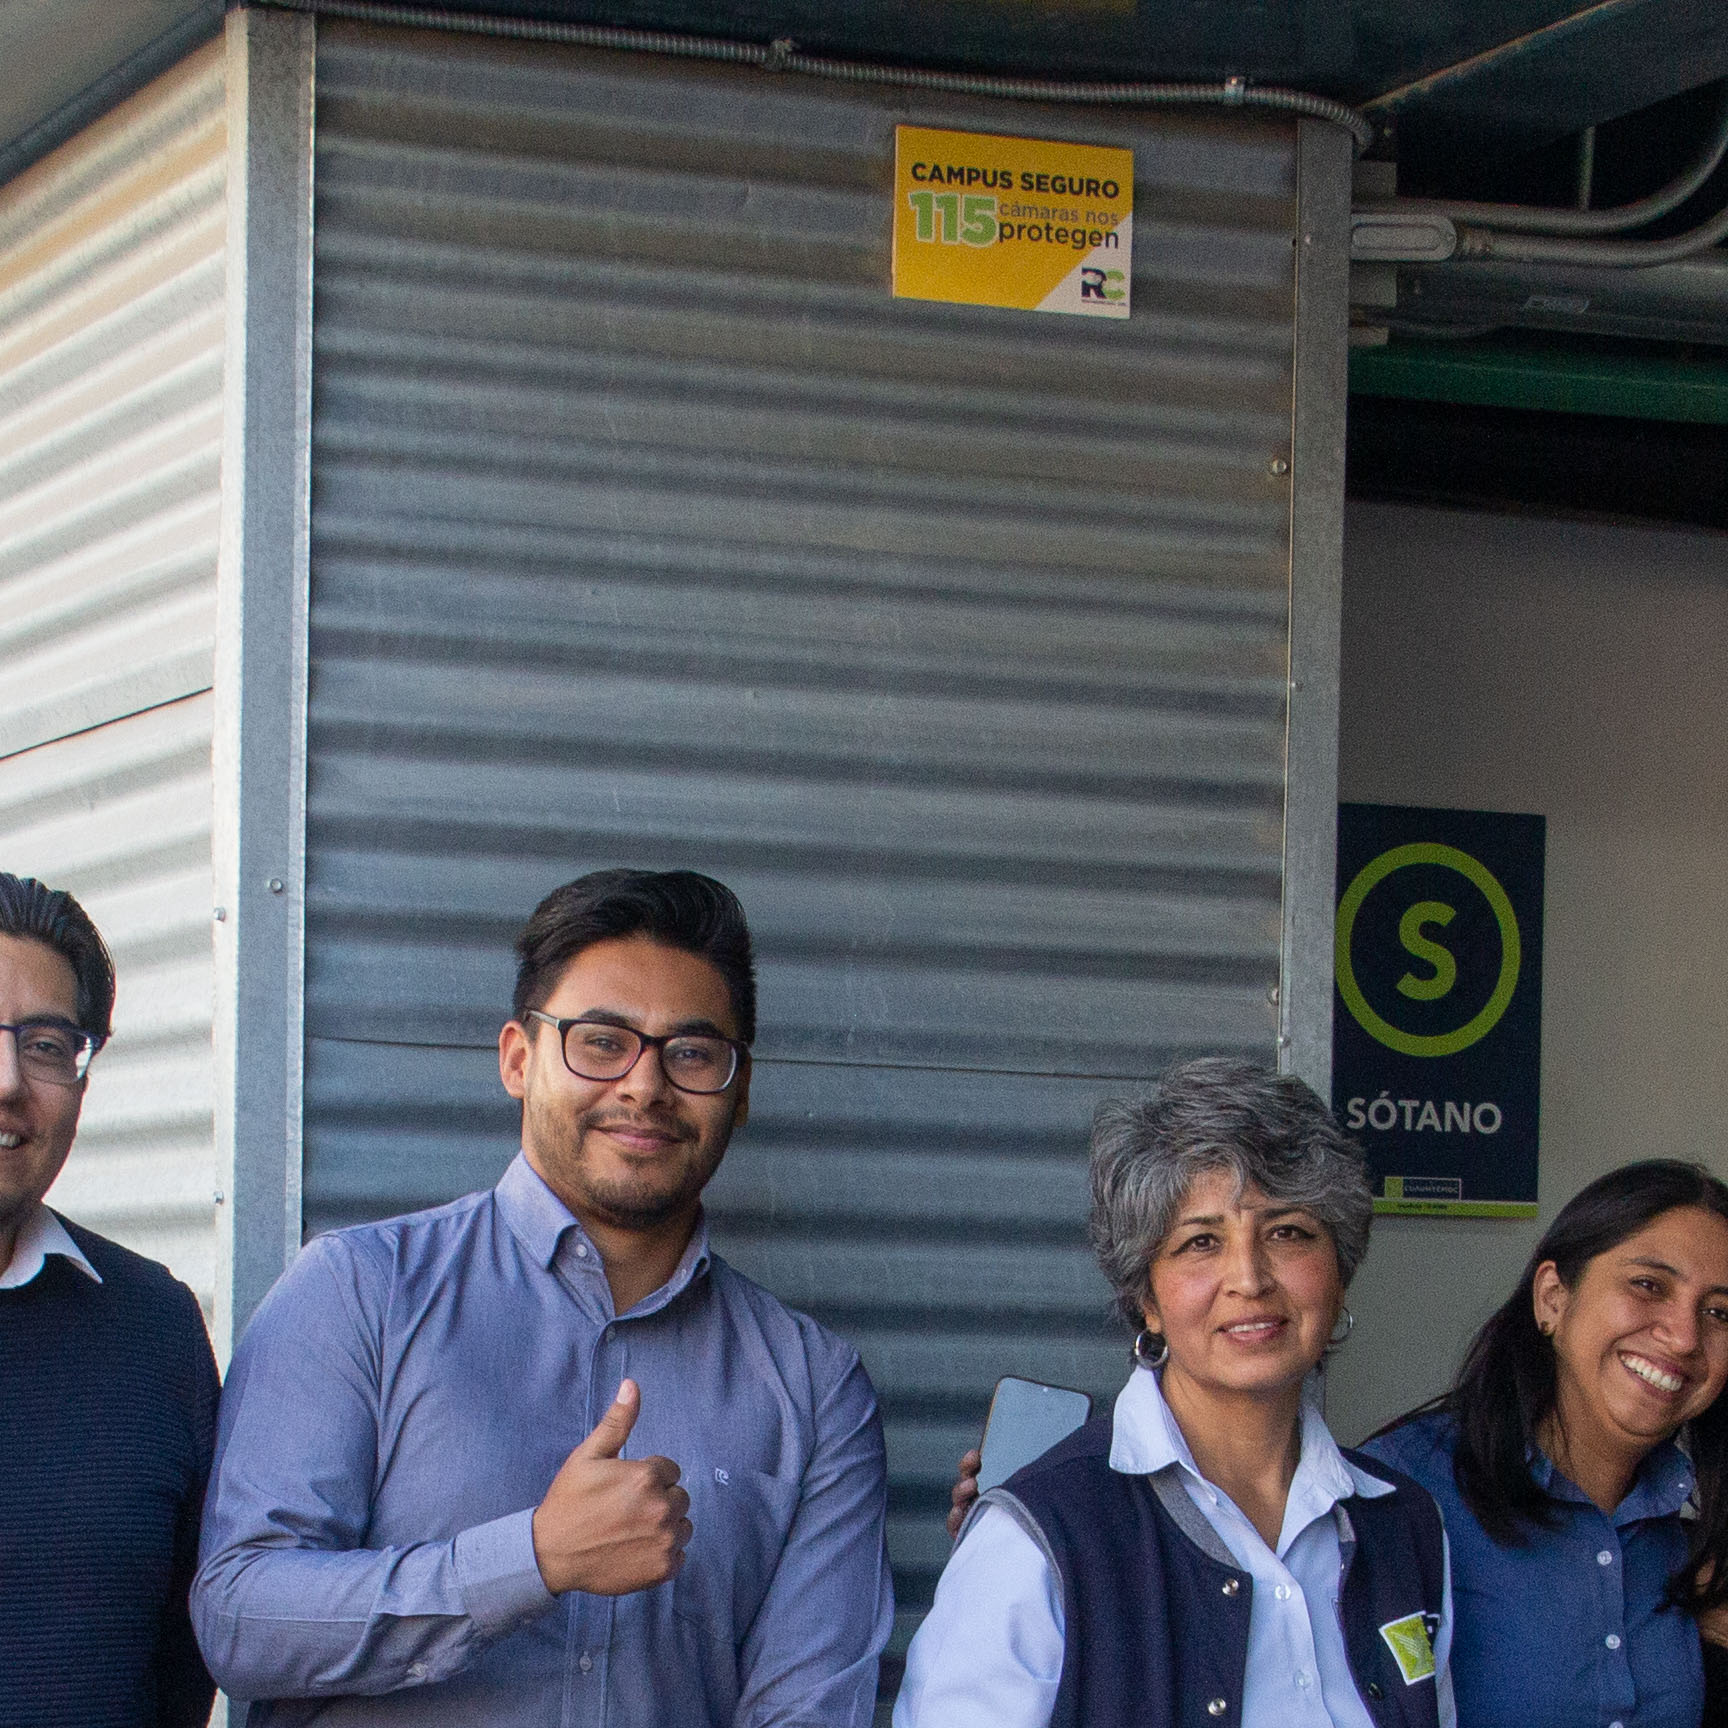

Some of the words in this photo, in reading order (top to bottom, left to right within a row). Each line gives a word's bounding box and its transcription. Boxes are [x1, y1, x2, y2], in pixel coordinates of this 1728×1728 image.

[911, 162, 1013, 190] CAMPUS
[1020, 172, 1120, 199] SEGURO
[909, 190, 999, 248] 115
[1085, 209, 1120, 226] nos
[998, 222, 1119, 250] protegen
[1395, 900, 1457, 1001] S
[1346, 1091, 1503, 1135] SÓTANO
